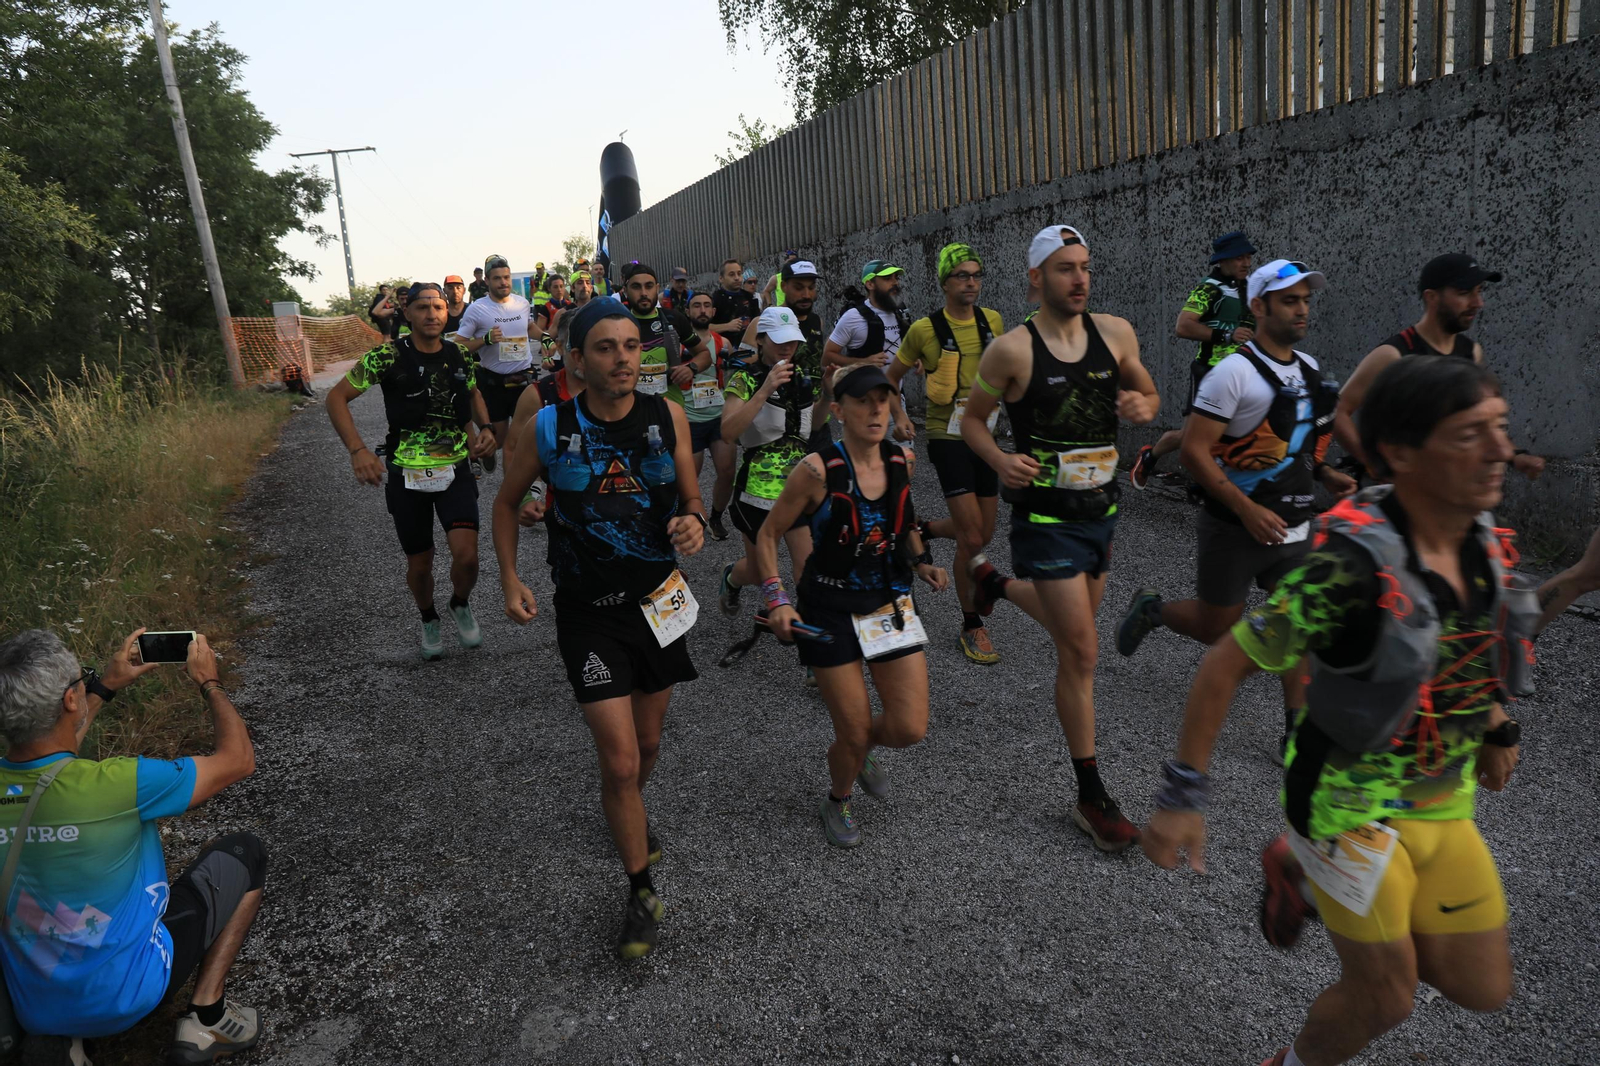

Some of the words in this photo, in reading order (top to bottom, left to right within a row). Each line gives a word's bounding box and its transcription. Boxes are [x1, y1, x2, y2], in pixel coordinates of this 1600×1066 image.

[513, 344, 518, 352] 5
[641, 375, 654, 383] 43
[705, 388, 715, 397] 15
[425, 468, 433, 478] 6
[1089, 467, 1096, 481] 7
[670, 589, 686, 611] 59
